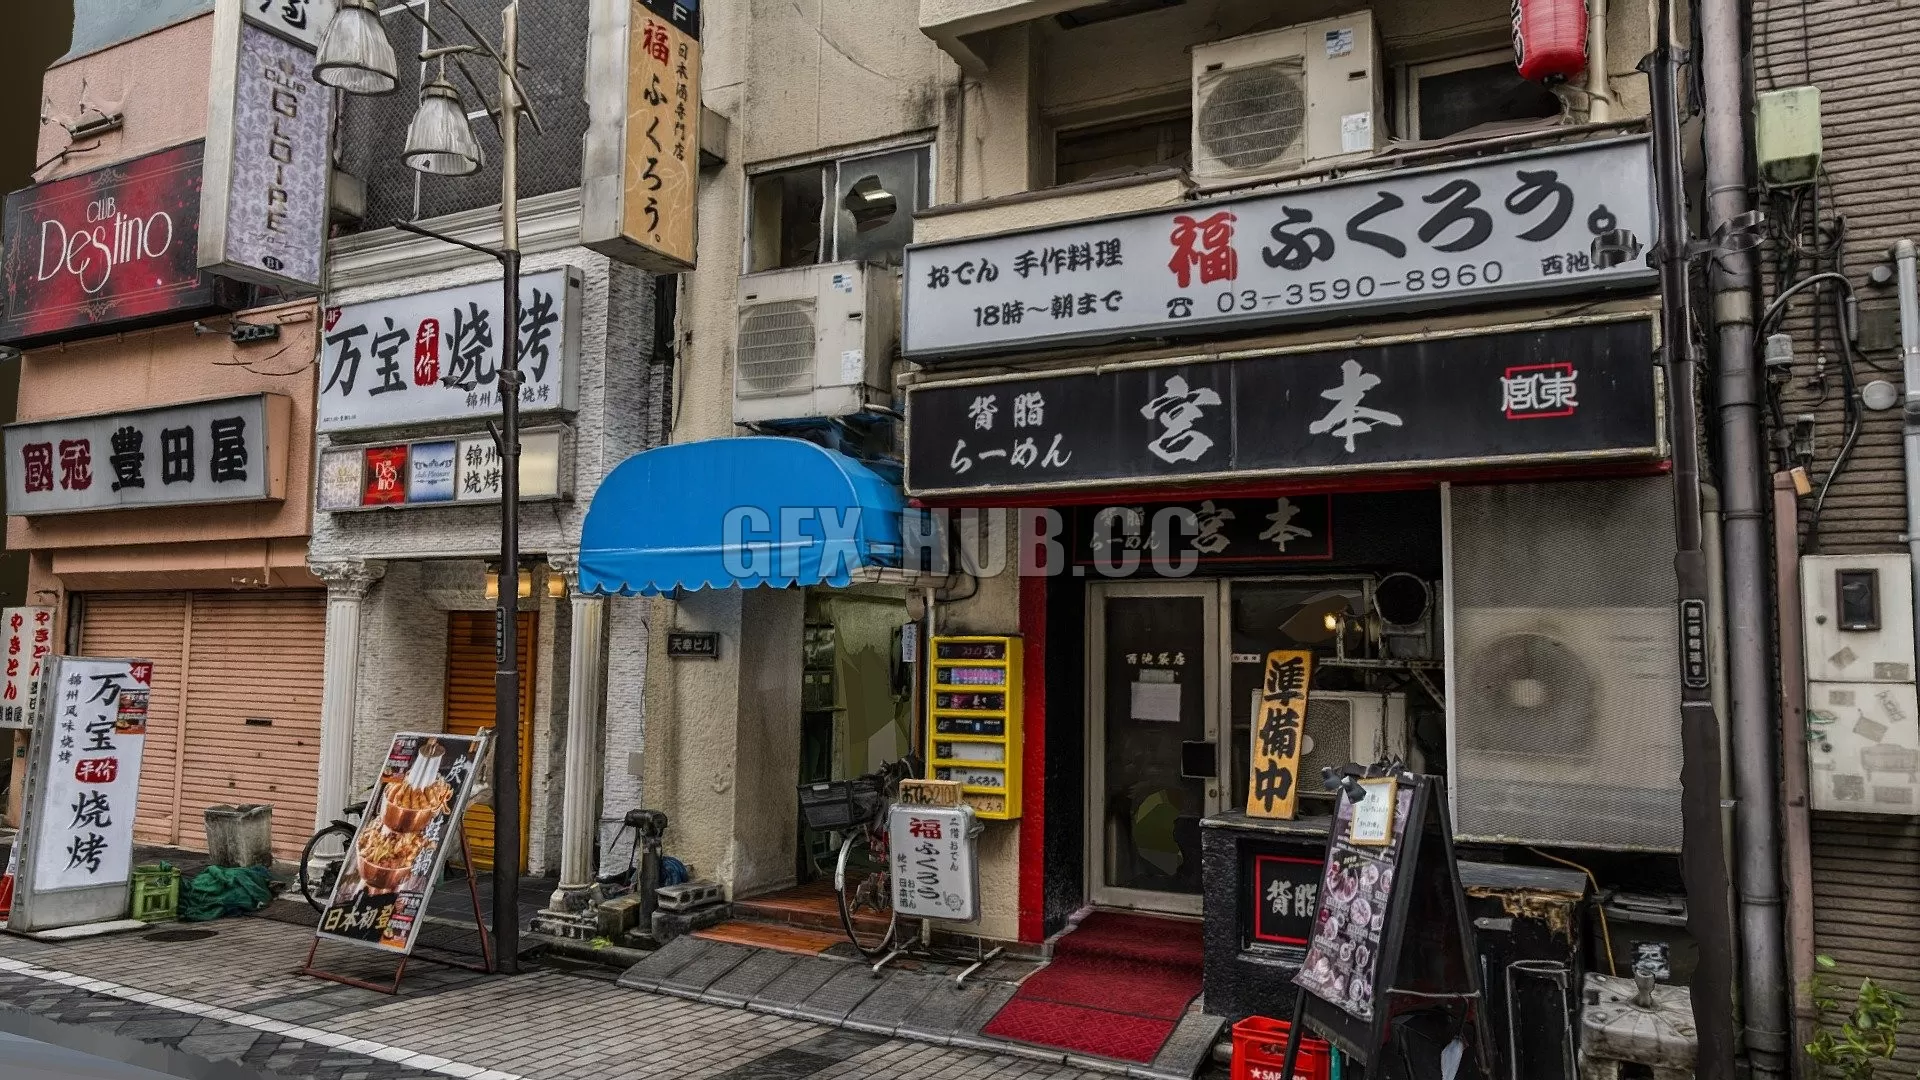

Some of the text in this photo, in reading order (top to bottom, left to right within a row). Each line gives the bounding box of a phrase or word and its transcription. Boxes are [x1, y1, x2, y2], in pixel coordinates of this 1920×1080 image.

[643, 18, 669, 67] 福
[87, 196, 115, 223] CLUB
[927, 237, 1123, 289] おでん 手作料理
[1168, 211, 1238, 288] 福
[1217, 260, 1503, 314] 03-3590-8960
[326, 310, 338, 324] 4F
[322, 316, 410, 397] 万宝
[416, 321, 437, 383] 平价
[968, 390, 1045, 430] 背脂
[1140, 359, 1403, 464] 宮本
[950, 433, 1072, 475] らーめん
[464, 468, 501, 494] 烧烤
[1186, 497, 1313, 554] 宮本
[4, 613, 23, 700] やきとん
[133, 666, 149, 678] 4F
[82, 673, 126, 752] 万宝
[1255, 656, 1305, 813] 準備中
[77, 760, 116, 779] 平价
[63, 790, 112, 874] 烧烤
[909, 817, 942, 839] 福
